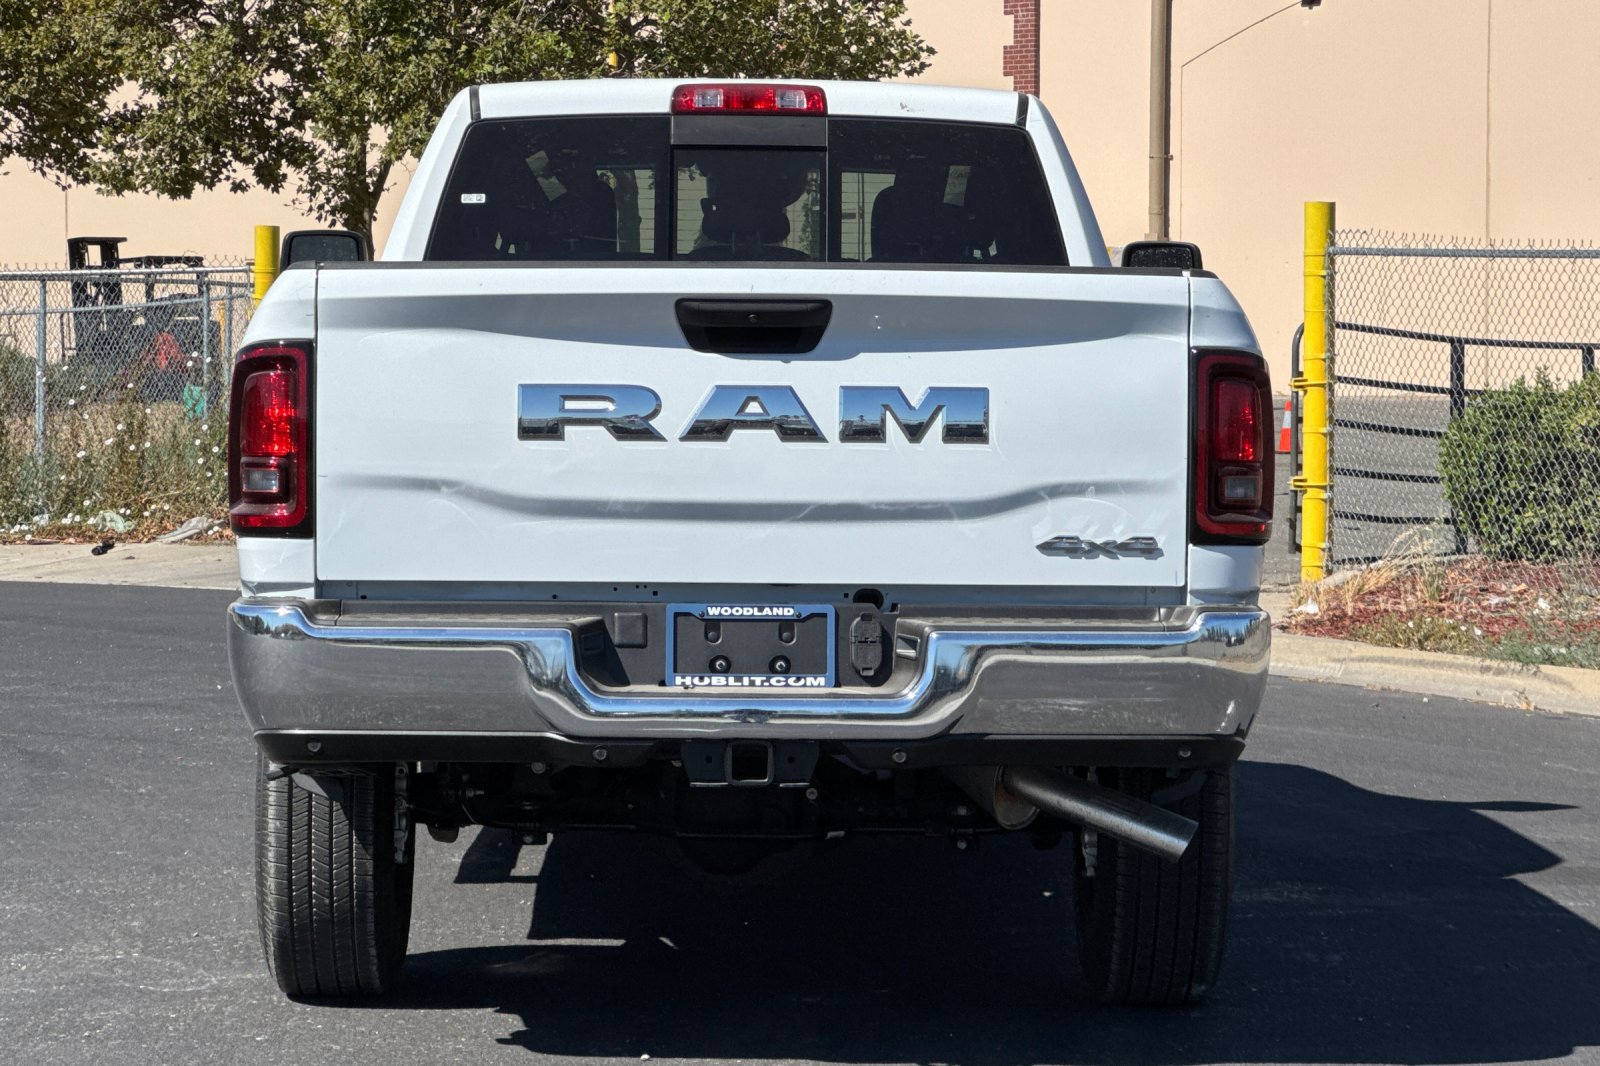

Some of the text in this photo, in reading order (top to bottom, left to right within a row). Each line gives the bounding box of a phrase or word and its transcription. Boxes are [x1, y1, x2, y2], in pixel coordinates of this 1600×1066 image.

[518, 384, 990, 444] RAM
[707, 606, 795, 616] WOODLAND
[674, 676, 826, 687] HUBLIT.COM
